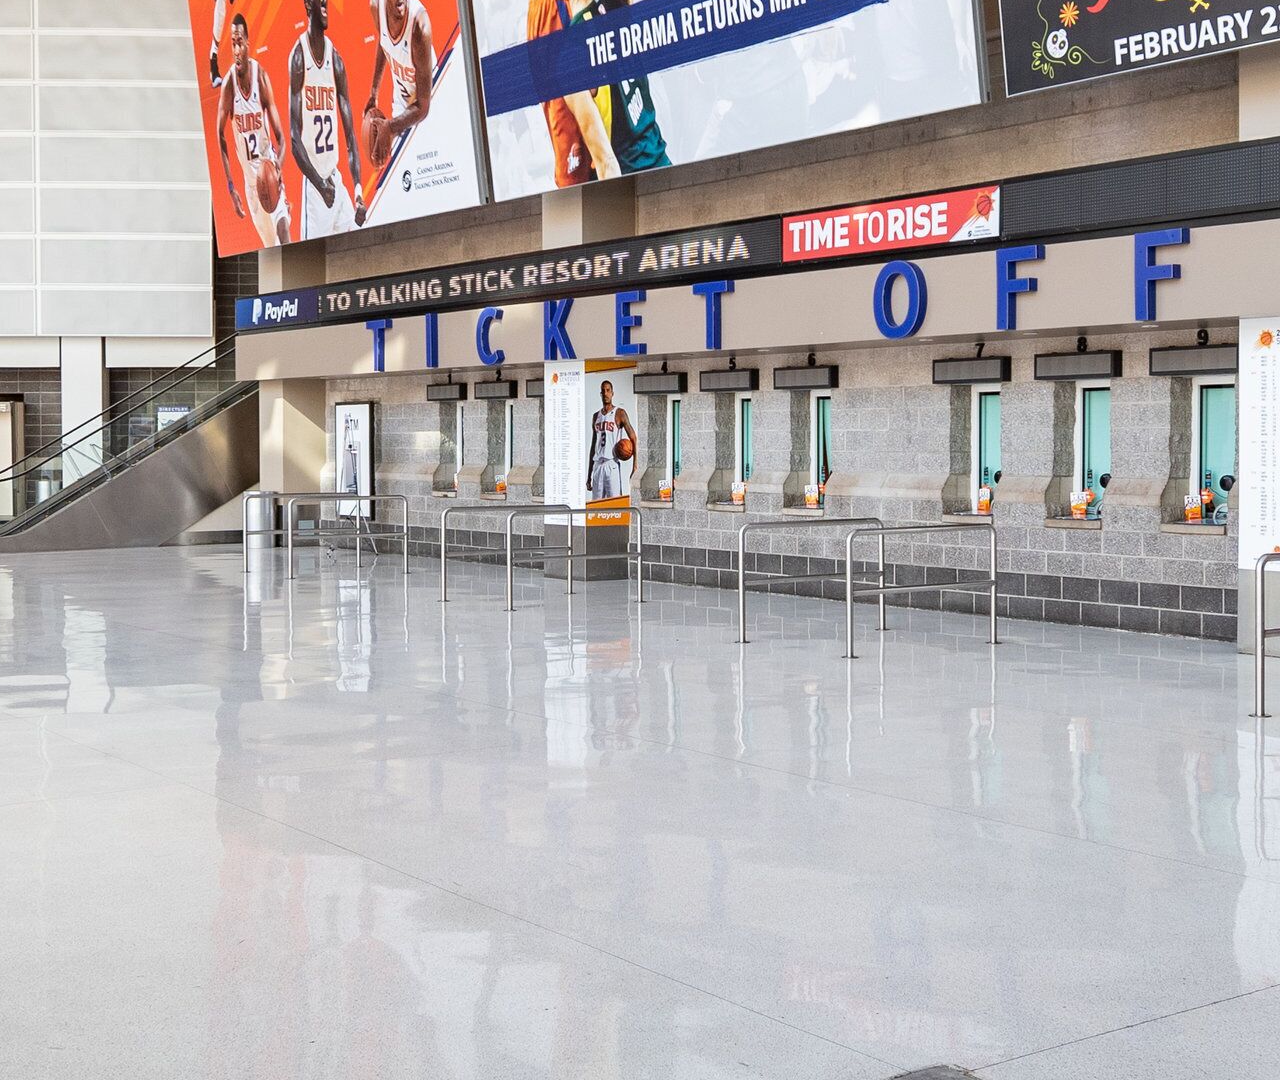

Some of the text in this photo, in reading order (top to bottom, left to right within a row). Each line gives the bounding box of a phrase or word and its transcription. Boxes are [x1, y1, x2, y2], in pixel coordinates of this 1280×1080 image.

[586, 34, 616, 67] THE
[620, 12, 679, 58] DRAMA
[1114, 10, 1253, 66] FEBRUARY
[305, 85, 335, 111] SUNS
[234, 112, 262, 134] SUNS
[314, 115, 334, 154] 22
[245, 133, 259, 160] 12
[789, 201, 948, 253] TIME TO RISE
[328, 235, 750, 312] TO TALKING STICK RESORT ARENA
[264, 297, 299, 322] PayPal
[365, 279, 736, 373] TICKET
[1196, 329, 1209, 347] 9
[974, 342, 985, 359] 7
[1076, 336, 1088, 353] 8
[661, 361, 669, 374] 4
[728, 357, 737, 371] 5
[807, 352, 817, 366] 6
[495, 368, 502, 381] 2
